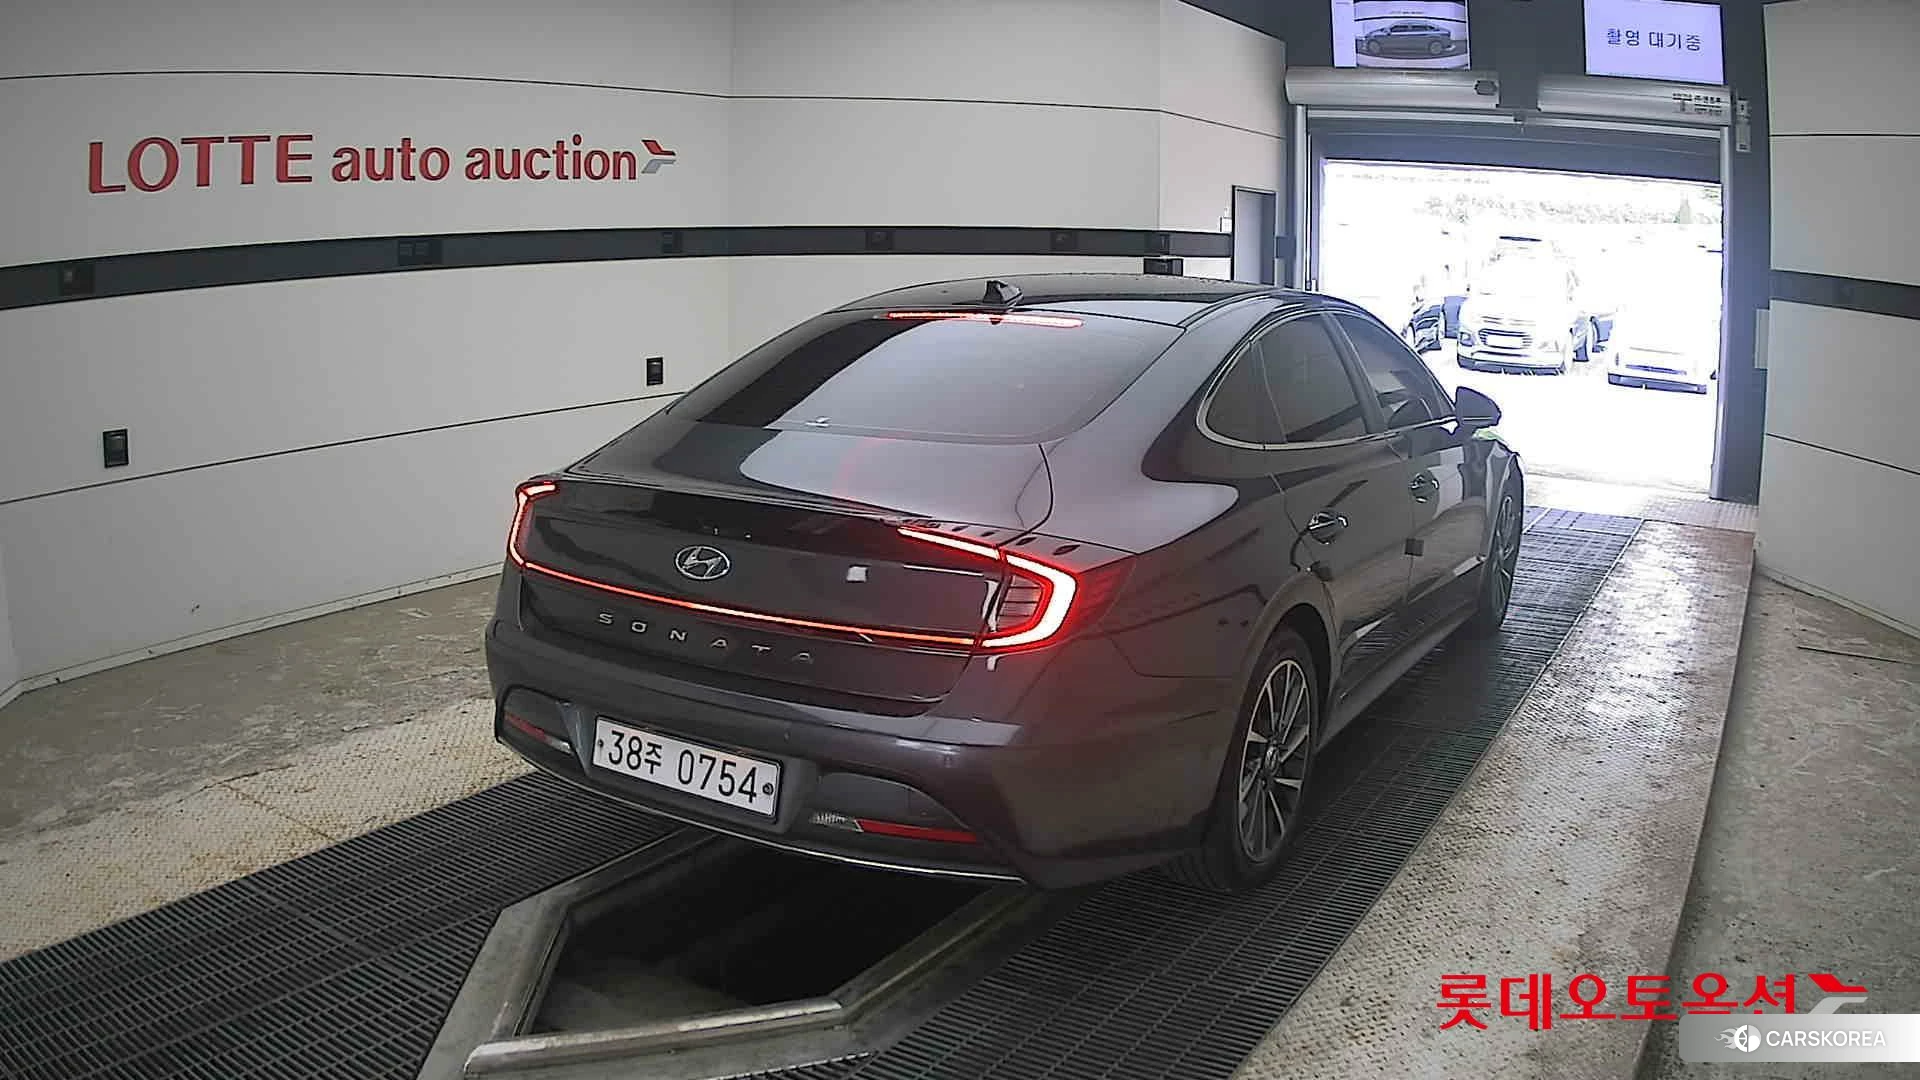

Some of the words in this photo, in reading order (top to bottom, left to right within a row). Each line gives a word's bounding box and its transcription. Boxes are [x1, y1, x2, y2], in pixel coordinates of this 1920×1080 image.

[1648, 31, 1702, 52] 대기중
[88, 134, 313, 194] LOTTE
[331, 137, 451, 182] auto
[464, 134, 637, 181] auction
[598, 612, 816, 666] SONATA
[608, 729, 663, 776] 38주
[676, 748, 758, 804] 0754
